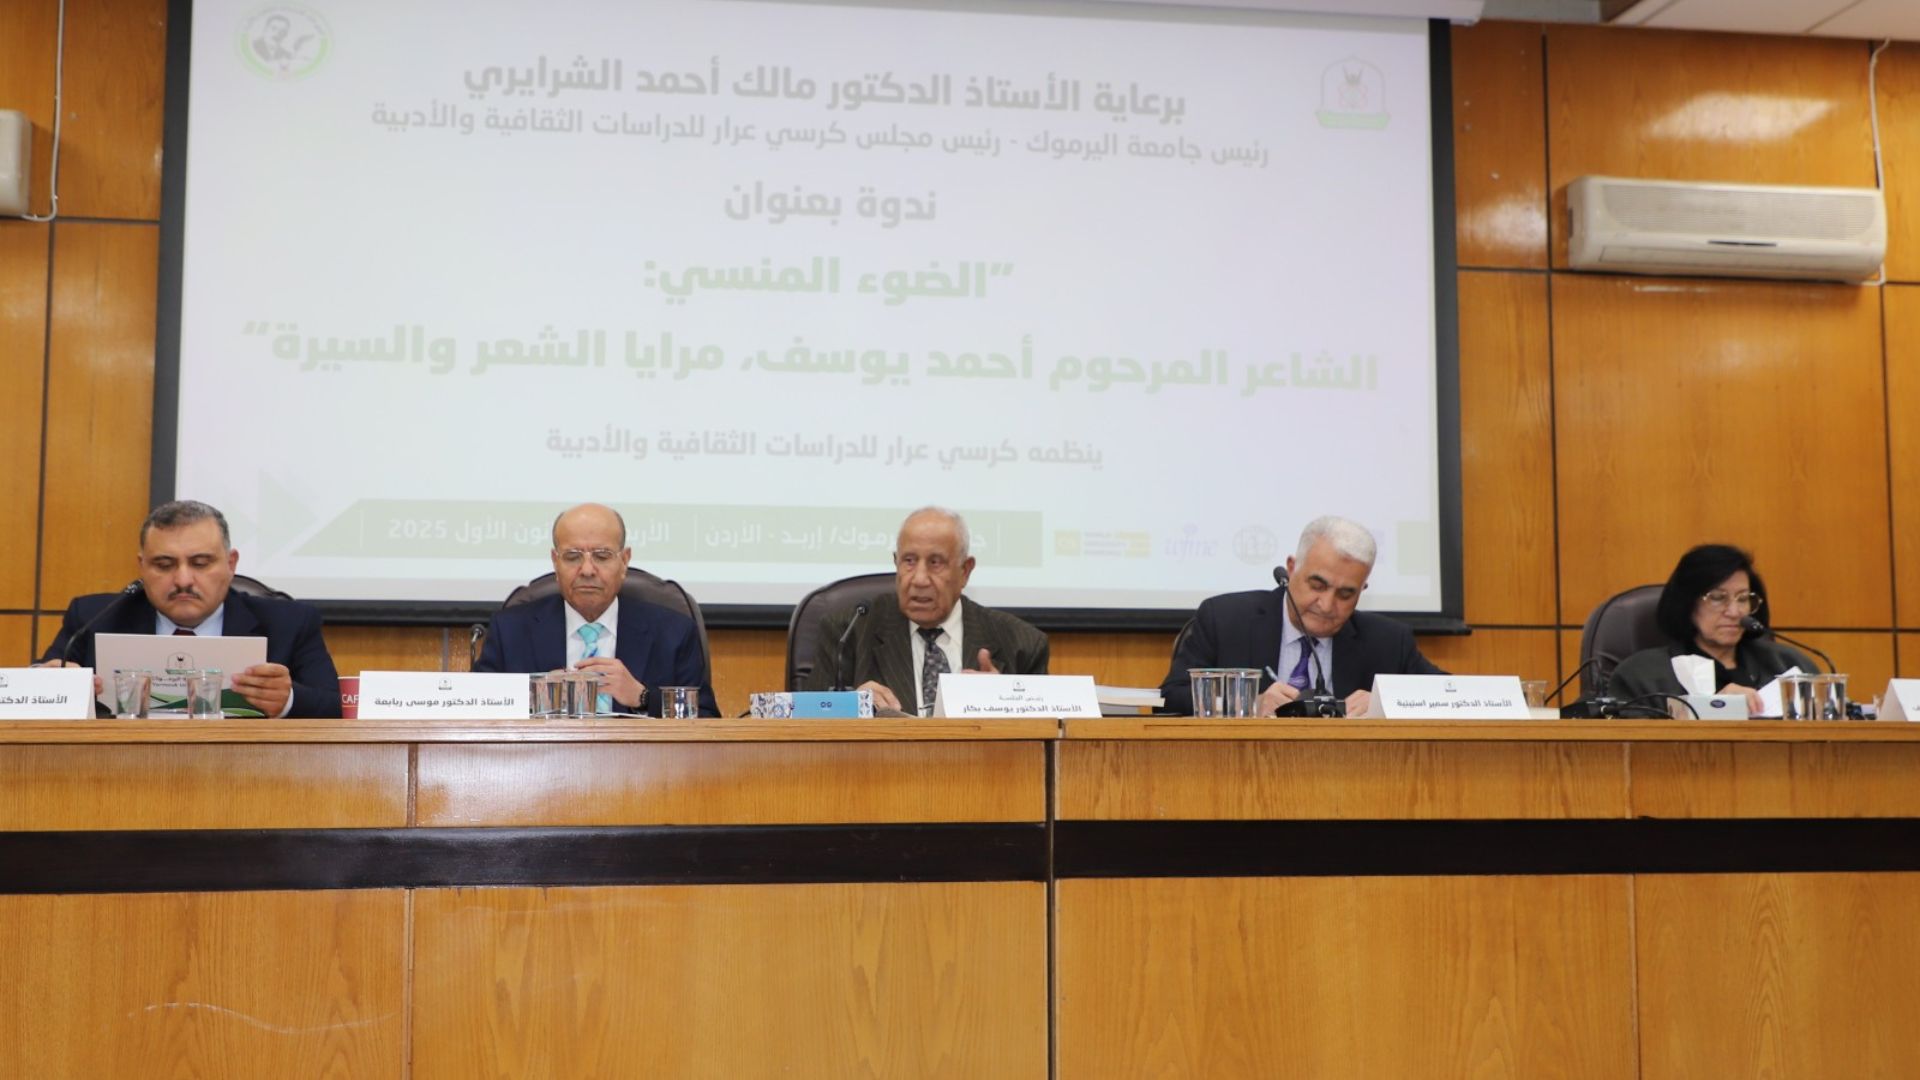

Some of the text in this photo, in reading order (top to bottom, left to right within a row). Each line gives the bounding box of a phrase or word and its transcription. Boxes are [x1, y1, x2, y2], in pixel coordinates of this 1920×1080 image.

[462, 54, 1187, 125] برعاية الأستاذ الدكتور مالك أحمد الشرايري
[371, 99, 475, 136] والأدبية
[484, 105, 583, 136] الثقافية
[592, 111, 706, 144] للدراسات
[712, 116, 756, 147] عرار
[765, 121, 847, 151] كرسي
[855, 123, 933, 154] مجلس
[941, 131, 1001, 158] رئيس
[1026, 130, 1118, 162] اليرموك
[1126, 133, 1203, 164] جامعة
[1210, 143, 1269, 169] رئيس
[723, 180, 937, 229] ندوة بعنوان
[644, 256, 840, 305] المنسي:
[469, 325, 606, 376] الشعر
[625, 331, 724, 380] مرايا
[740, 336, 909, 386] يوسف،
[926, 334, 1033, 379] أحمد
[1049, 349, 1228, 393] المرحوم
[1241, 349, 1378, 397] الشاعر
[546, 423, 1102, 471] ينظمه كرسي عرار للدراسات الثقافية والأدبية
[388, 518, 448, 539] 2025
[455, 513, 507, 545] الأول
[704, 520, 762, 547] الأردن
[0, 694, 68, 705] الأستاذ الدكت
[342, 694, 359, 704] CAF
[406, 698, 440, 708] موسى
[442, 697, 478, 708] الدكتور
[480, 696, 515, 707] الأستاذ
[1016, 704, 1049, 714] الدكتور
[1051, 704, 1082, 713] الأستاذ
